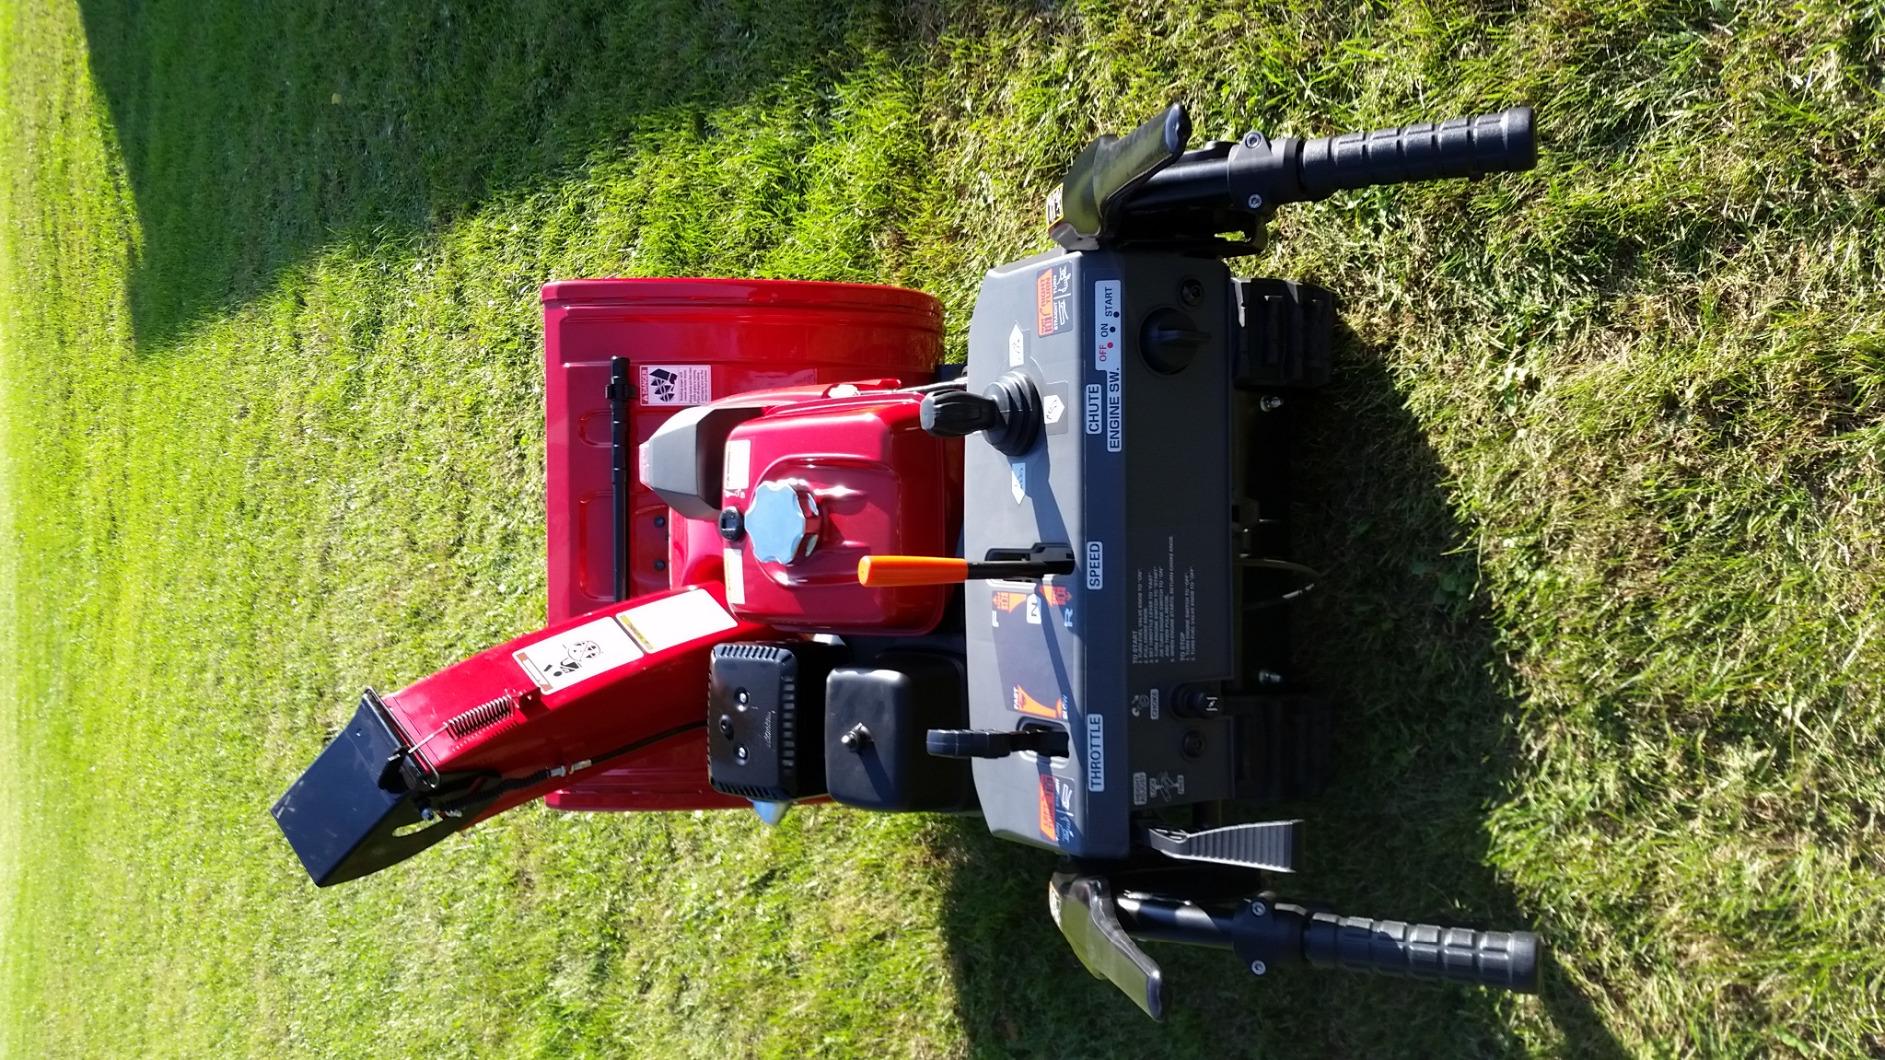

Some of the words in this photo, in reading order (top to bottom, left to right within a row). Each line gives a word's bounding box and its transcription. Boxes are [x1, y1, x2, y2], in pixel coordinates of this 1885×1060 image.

[1104, 286, 1113, 317] START
[1101, 323, 1109, 338] ON
[1099, 345, 1107, 362] OFF
[1109, 367, 1120, 392] SW.
[1088, 386, 1100, 432] CHUTE
[1109, 396, 1120, 448] ENGINE
[1089, 543, 1100, 587] SPEED
[1030, 602, 1038, 617] N
[1064, 608, 1073, 628] R
[1090, 717, 1101, 788] THROTTLE
